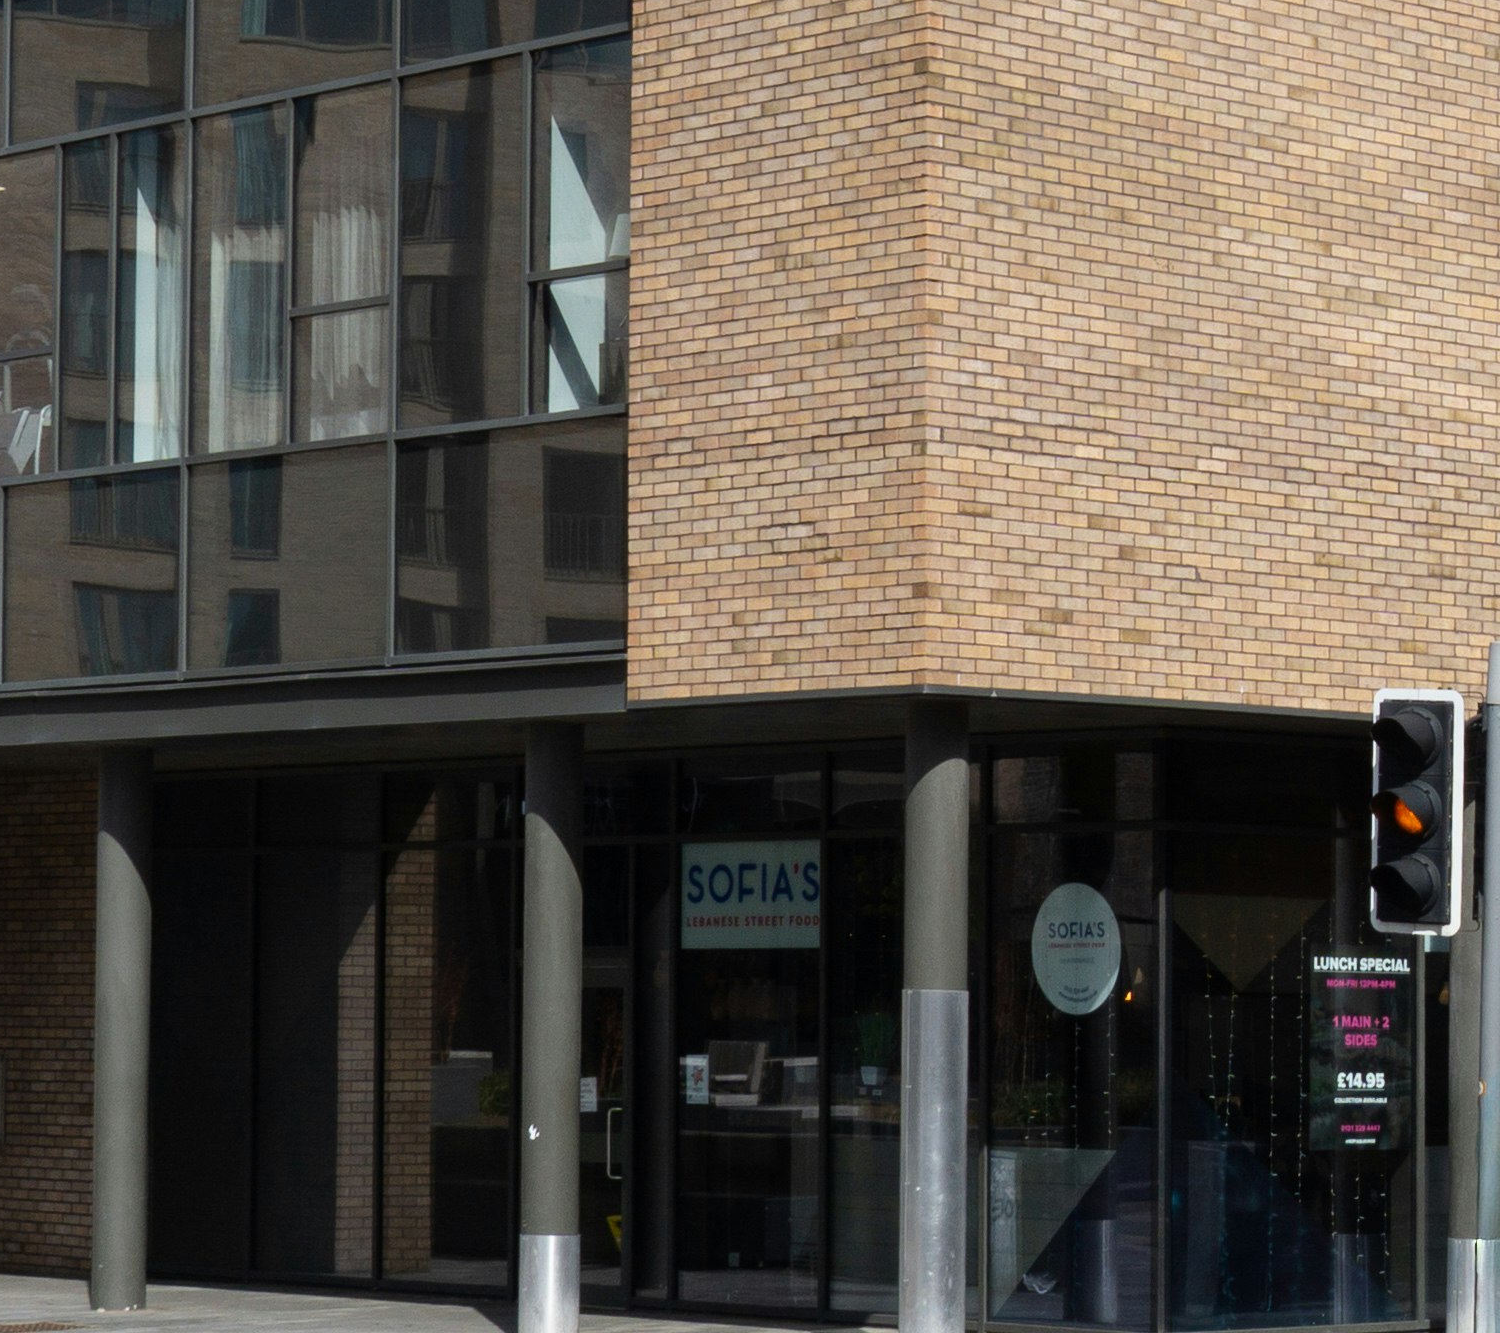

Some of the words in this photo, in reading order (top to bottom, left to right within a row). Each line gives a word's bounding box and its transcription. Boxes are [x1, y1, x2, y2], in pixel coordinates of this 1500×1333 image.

[687, 861, 820, 904] SOFIA'S
[686, 916, 740, 927] LEBANESE
[744, 915, 785, 927] STREET
[789, 915, 820, 926] FOOD
[1048, 921, 1106, 939] SOFIA'S
[1313, 956, 1358, 971] LUNCH
[1359, 957, 1411, 972] SPECIAL
[1326, 978, 1357, 988] MON-FRI
[1333, 1015, 1339, 1027] 1
[1341, 1015, 1371, 1028] MAIN
[1382, 1016, 1390, 1028] 2
[1344, 1033, 1378, 1046] SIDES
[1337, 1072, 1386, 1089] £14.95
